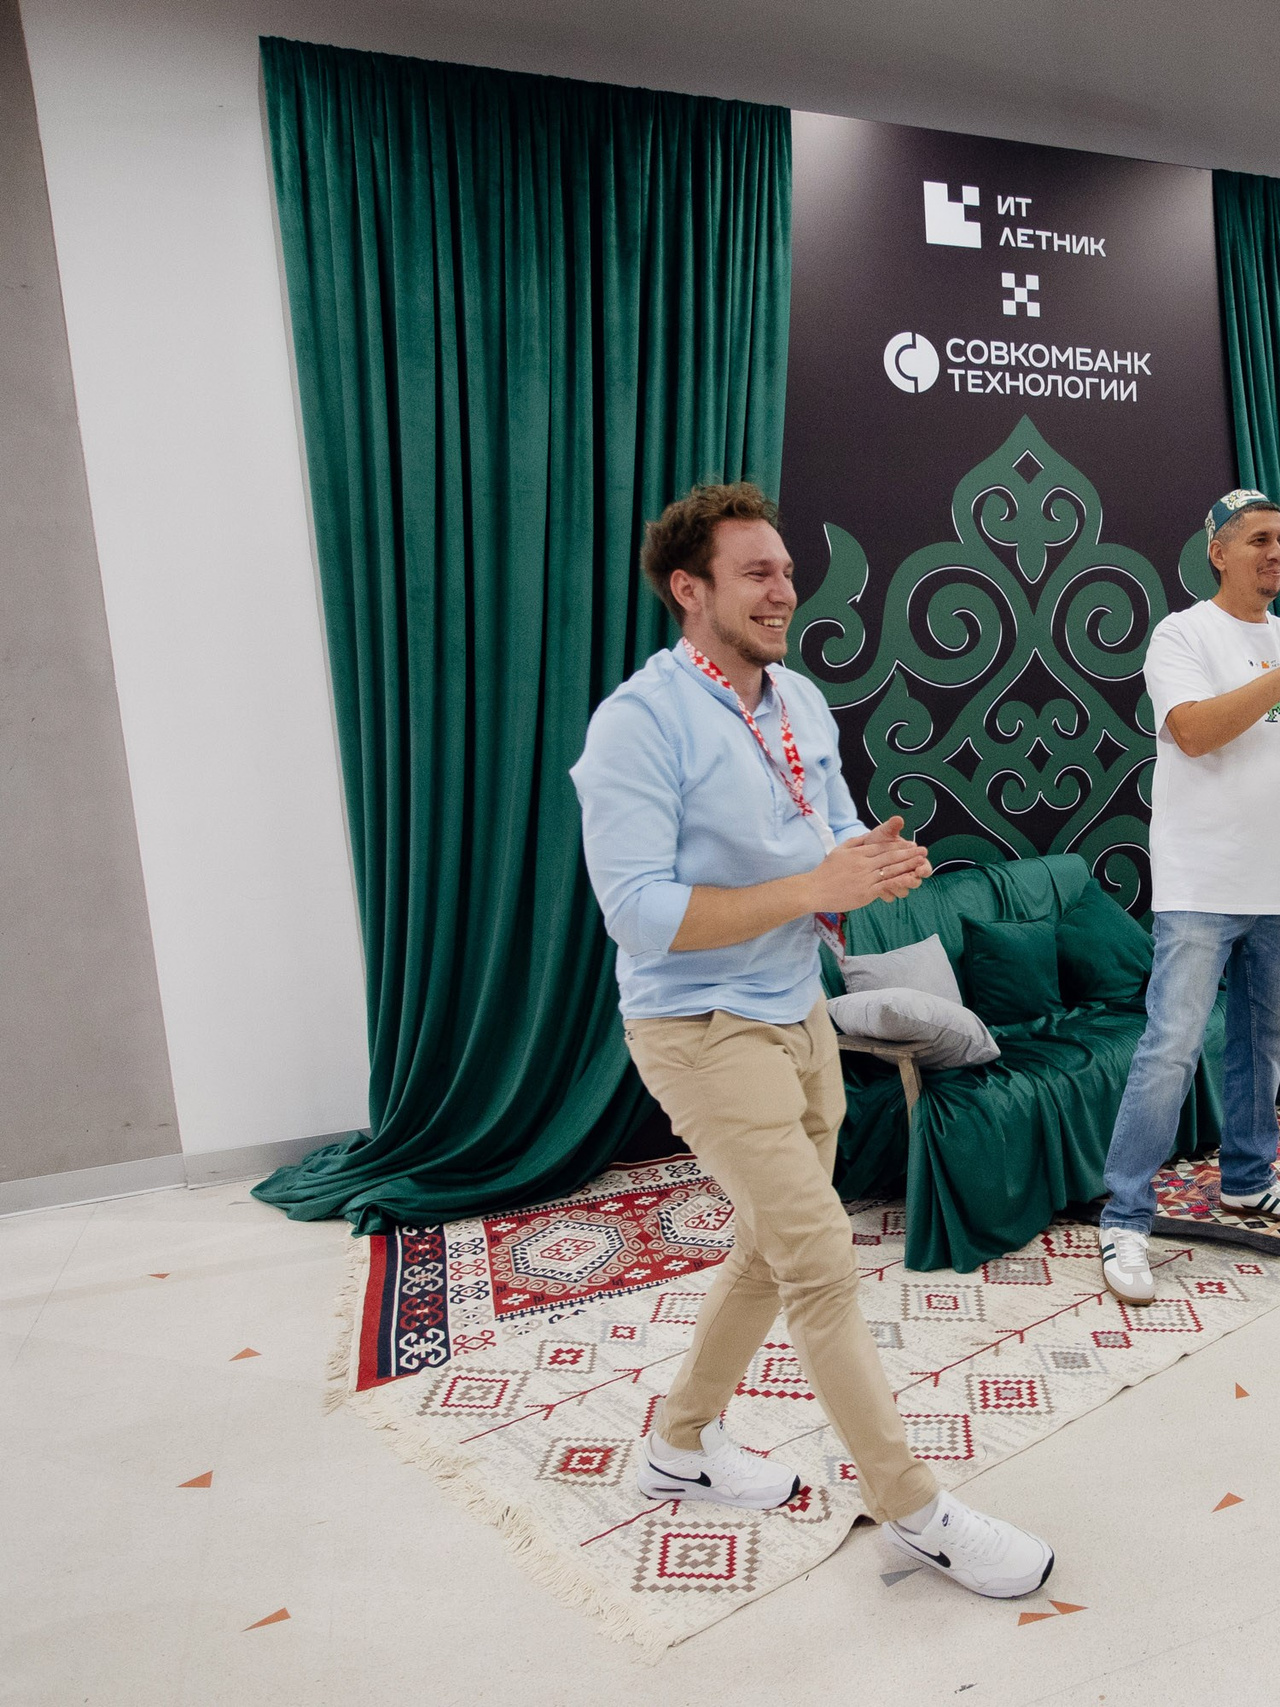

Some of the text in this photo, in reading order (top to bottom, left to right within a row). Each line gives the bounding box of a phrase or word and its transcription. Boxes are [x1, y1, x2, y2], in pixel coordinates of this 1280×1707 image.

[997, 195, 1032, 217] ИТ
[999, 226, 1107, 257] ЛЕТНИК
[945, 337, 1152, 376] СОВКОМБАНК
[947, 368, 1138, 402] ТЕХНОЛОГИИ
